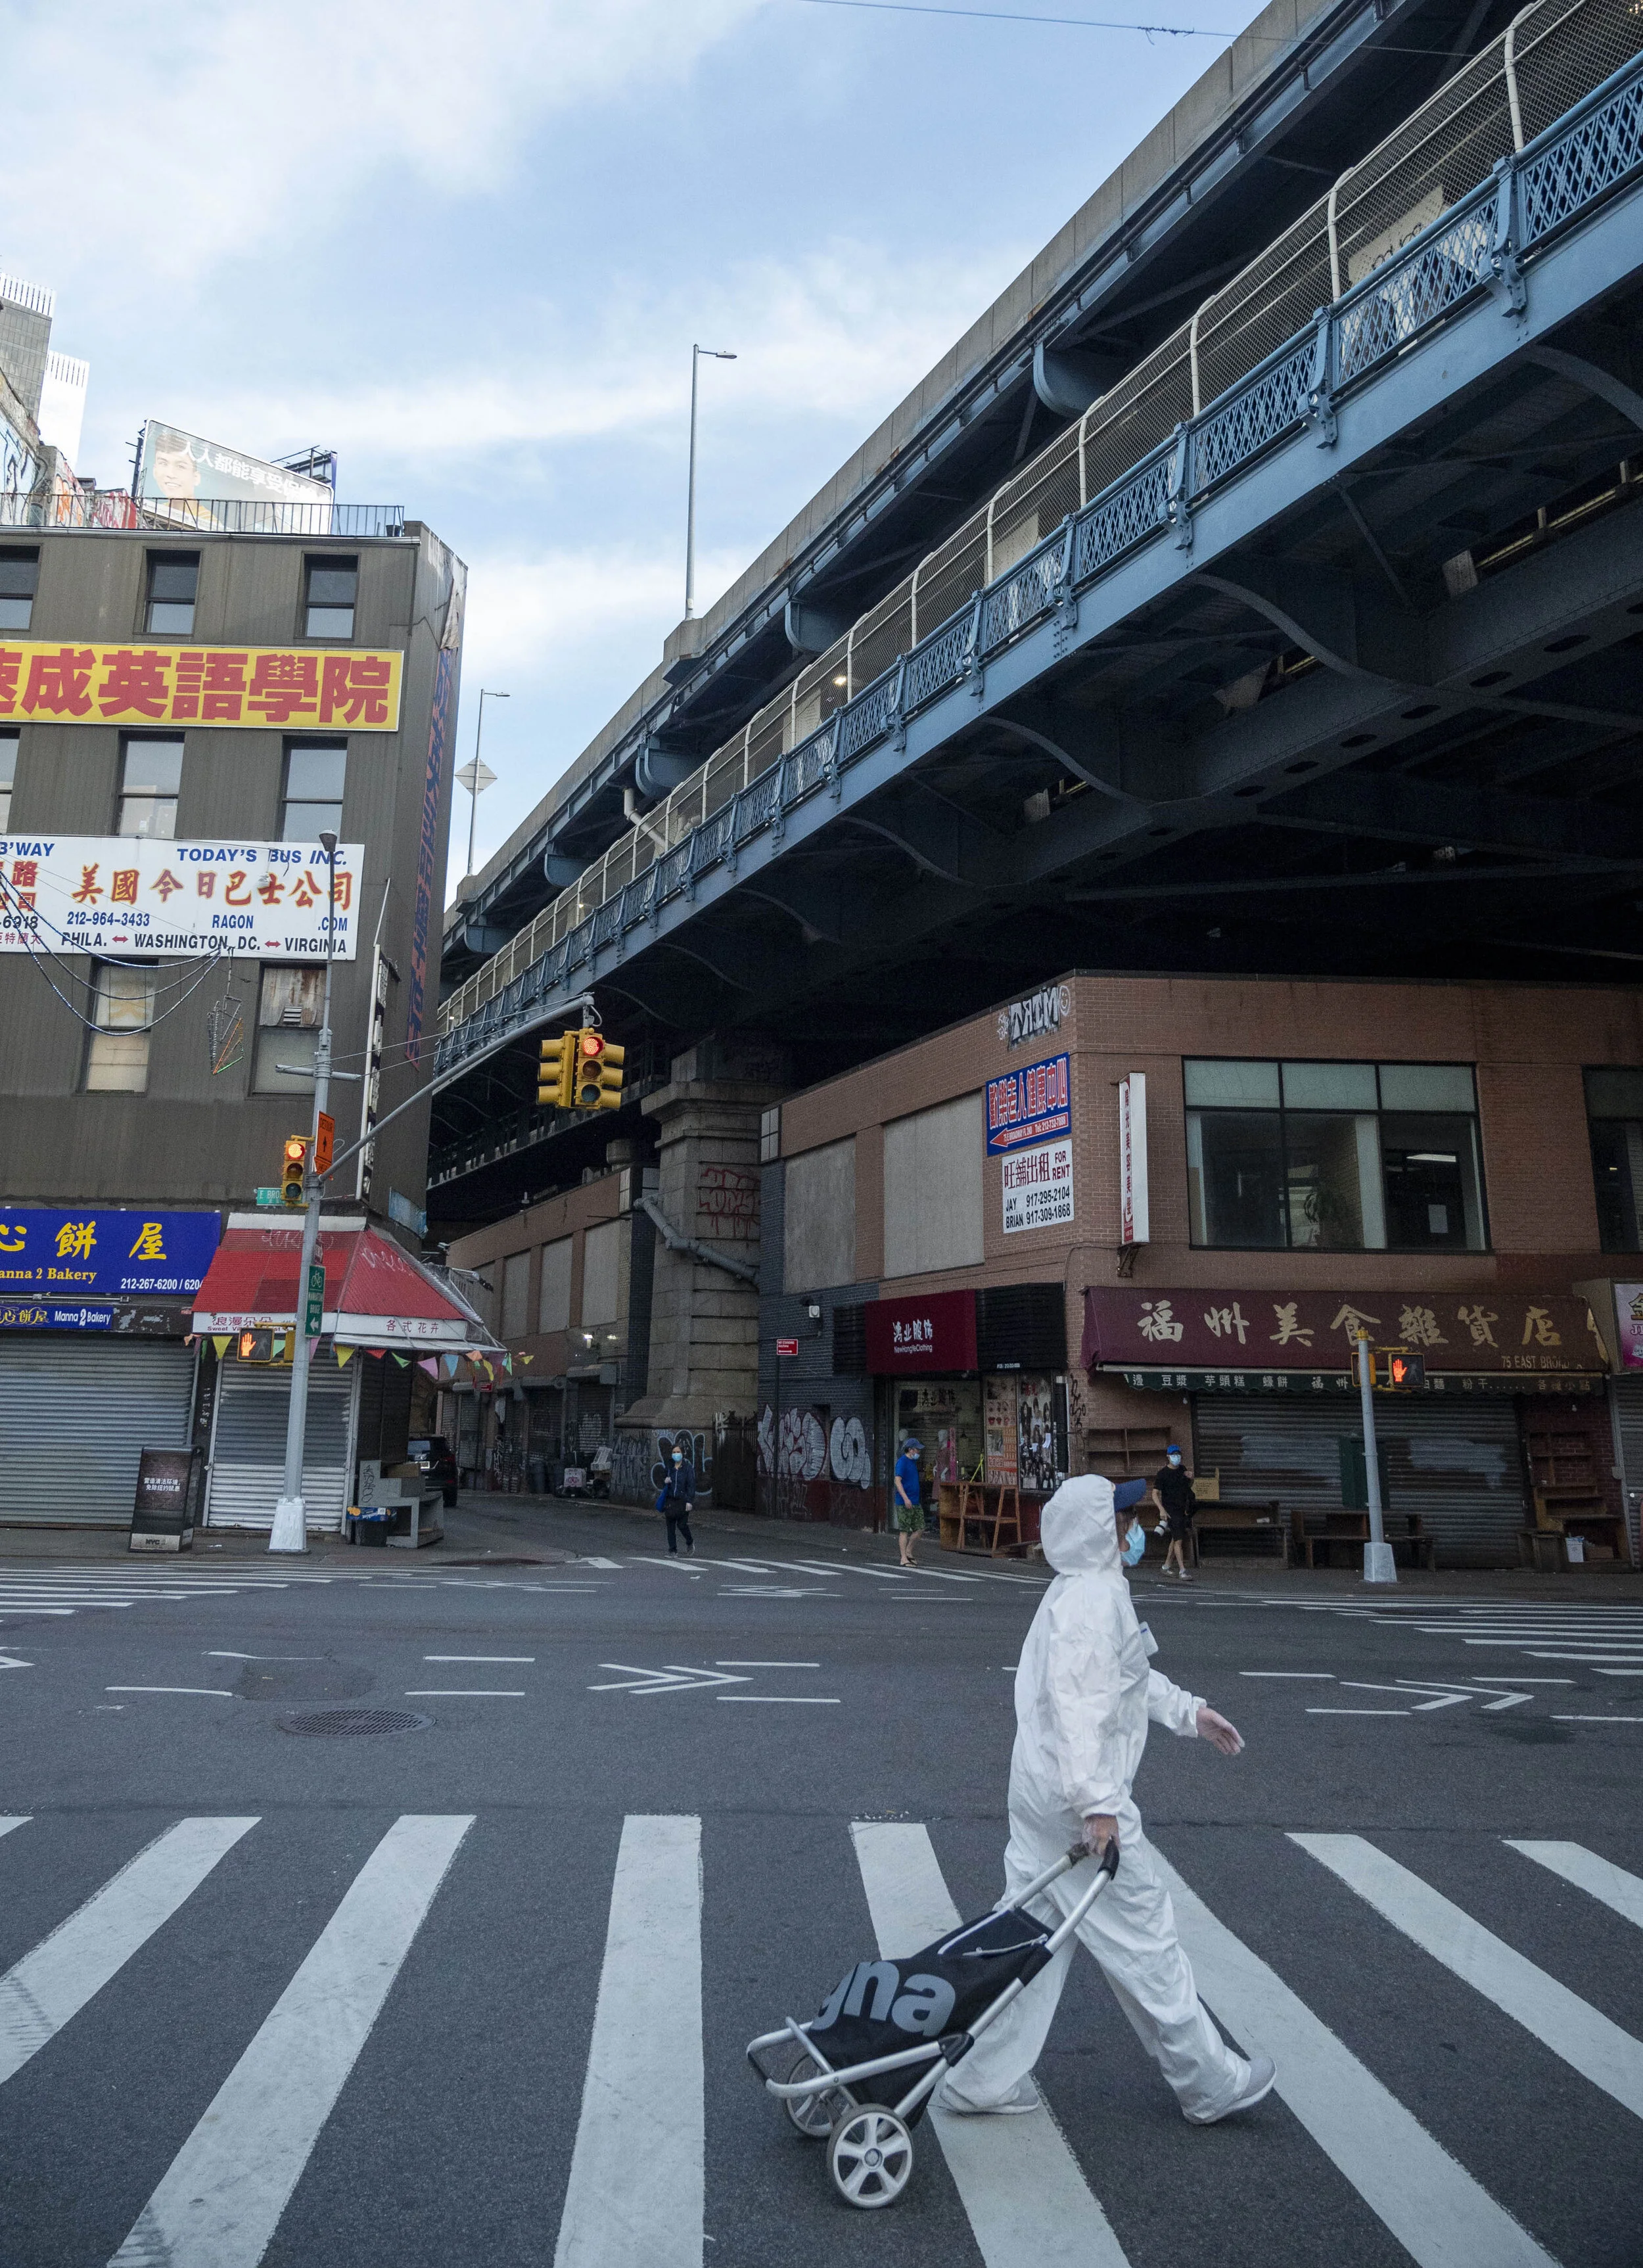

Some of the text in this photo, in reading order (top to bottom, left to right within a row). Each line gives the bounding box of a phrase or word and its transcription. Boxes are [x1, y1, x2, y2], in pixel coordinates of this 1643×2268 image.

[180, 441, 317, 500] 人人都能享受保
[177, 848, 347, 865] TODAY'S BUS INC.
[0, 860, 38, 887] 路
[72, 862, 353, 911] 美國今日巴士公司
[67, 912, 150, 927] 212-964-3433
[61, 932, 107, 946] PHILA.
[285, 938, 346, 952] VIRGINIA
[1055, 1150, 1066, 1163] FOR
[1004, 1151, 1050, 1189] 旺舖出租
[1052, 1164, 1070, 1180] RENT
[267, 1190, 281, 1199] BRO
[1006, 1185, 1070, 1212] JAY 917-295-2104
[1006, 1203, 1071, 1228] BRIAN 917-309-1868
[36, 1268, 43, 1280] 2
[47, 1268, 97, 1284] Bakery
[121, 1278, 177, 1290] 212-267-6200
[0, 1308, 49, 1325] 心餅屋
[55, 1308, 110, 1326] Manna 2 Bakery
[1137, 1300, 1562, 1348] 福州美食雜貨店
[386, 1320, 440, 1334] 各式花卉
[1501, 1356, 1512, 1369] 75
[1514, 1355, 1537, 1369] EAST
[1205, 1375, 1245, 1387] 芋頭糕
